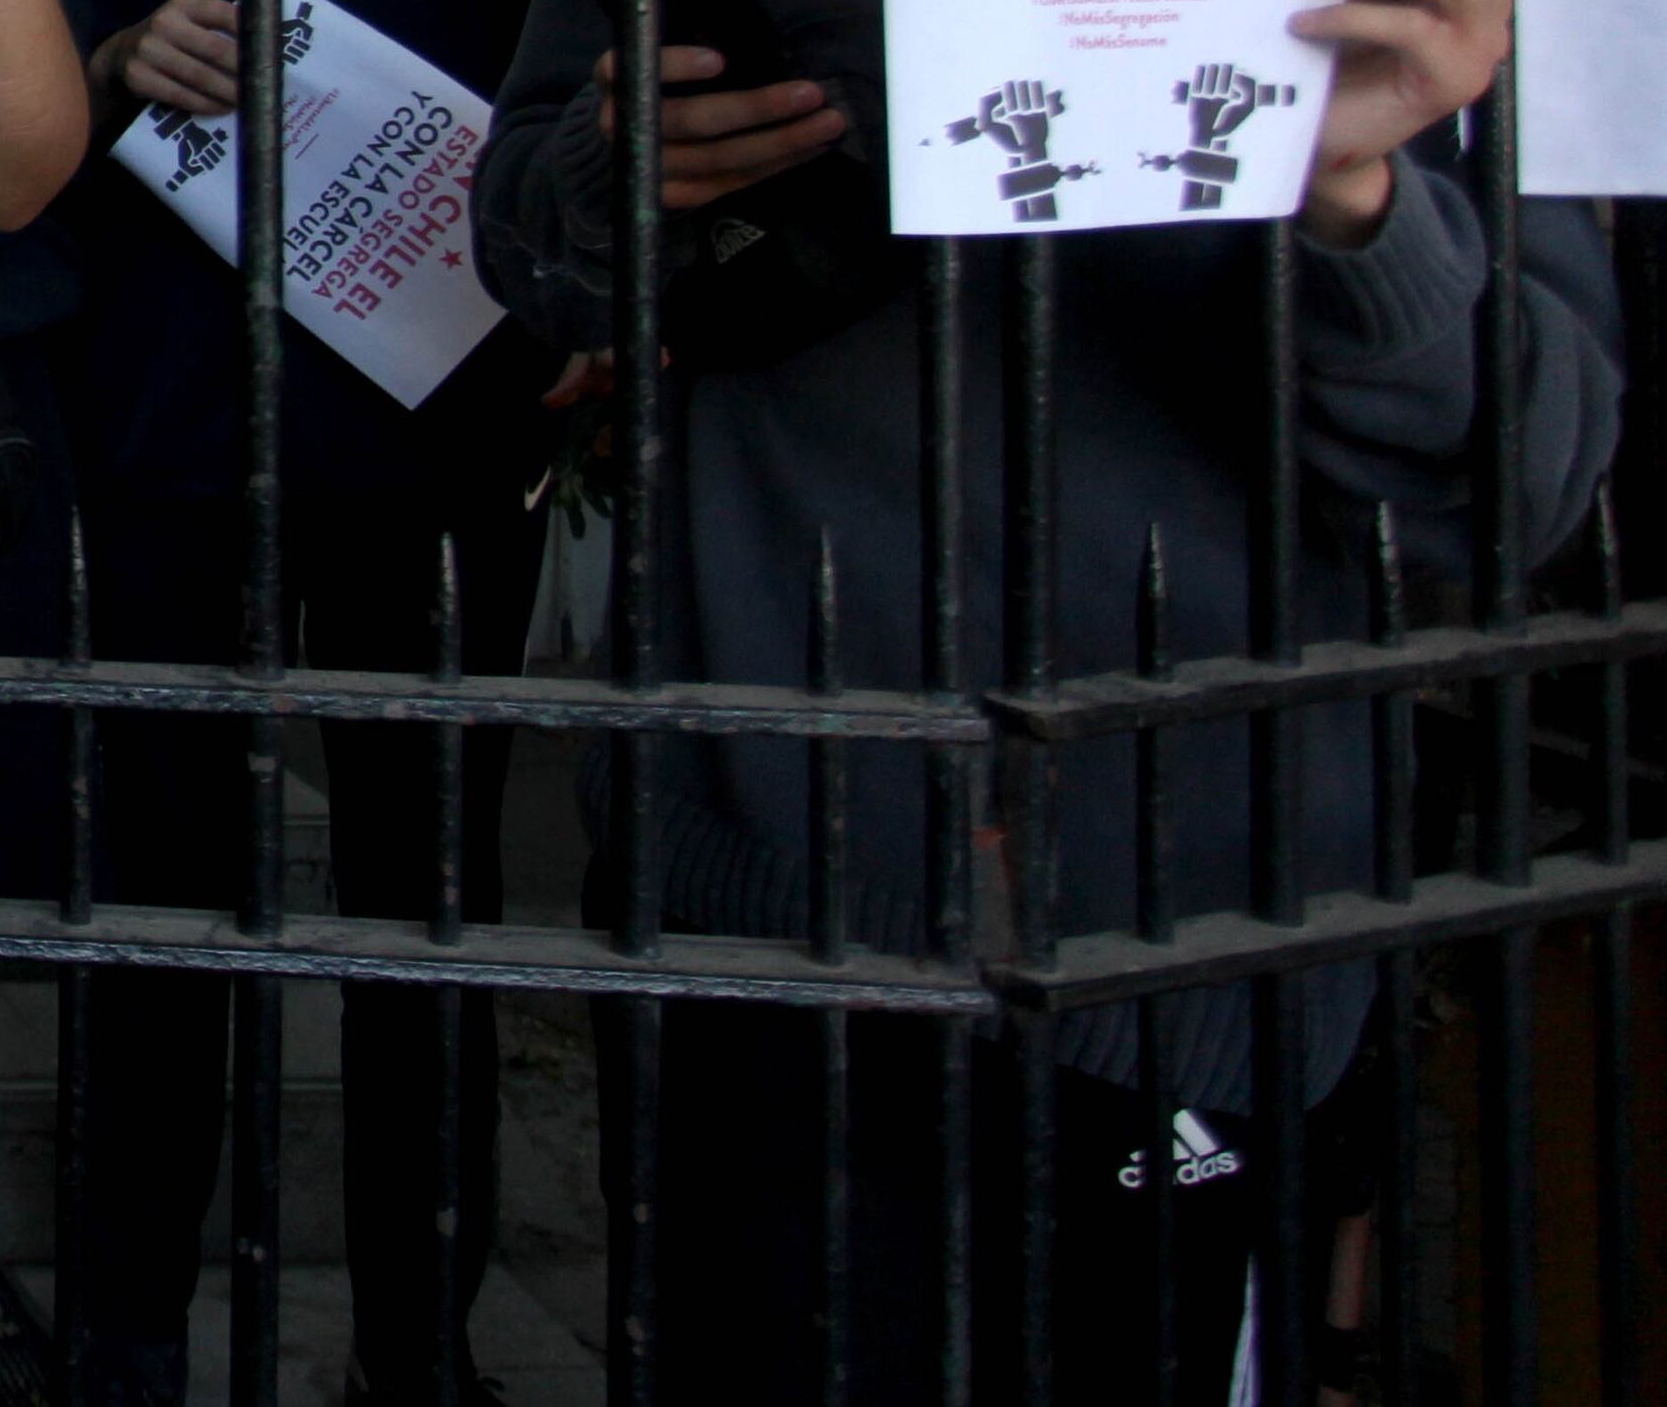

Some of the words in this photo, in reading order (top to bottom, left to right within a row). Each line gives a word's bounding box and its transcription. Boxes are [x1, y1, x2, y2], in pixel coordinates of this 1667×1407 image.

[411, 90, 434, 109] Y
[366, 106, 416, 157] CON
[394, 106, 453, 167] CON
[340, 152, 375, 181] LA
[363, 162, 405, 195] LA
[398, 124, 479, 210] ESTADO
[282, 180, 351, 252] ESCUEL
[311, 208, 404, 300] SEGREGA
[368, 194, 462, 290] CHILE
[332, 282, 382, 321] EL
[1118, 1151, 1240, 1188] adas
